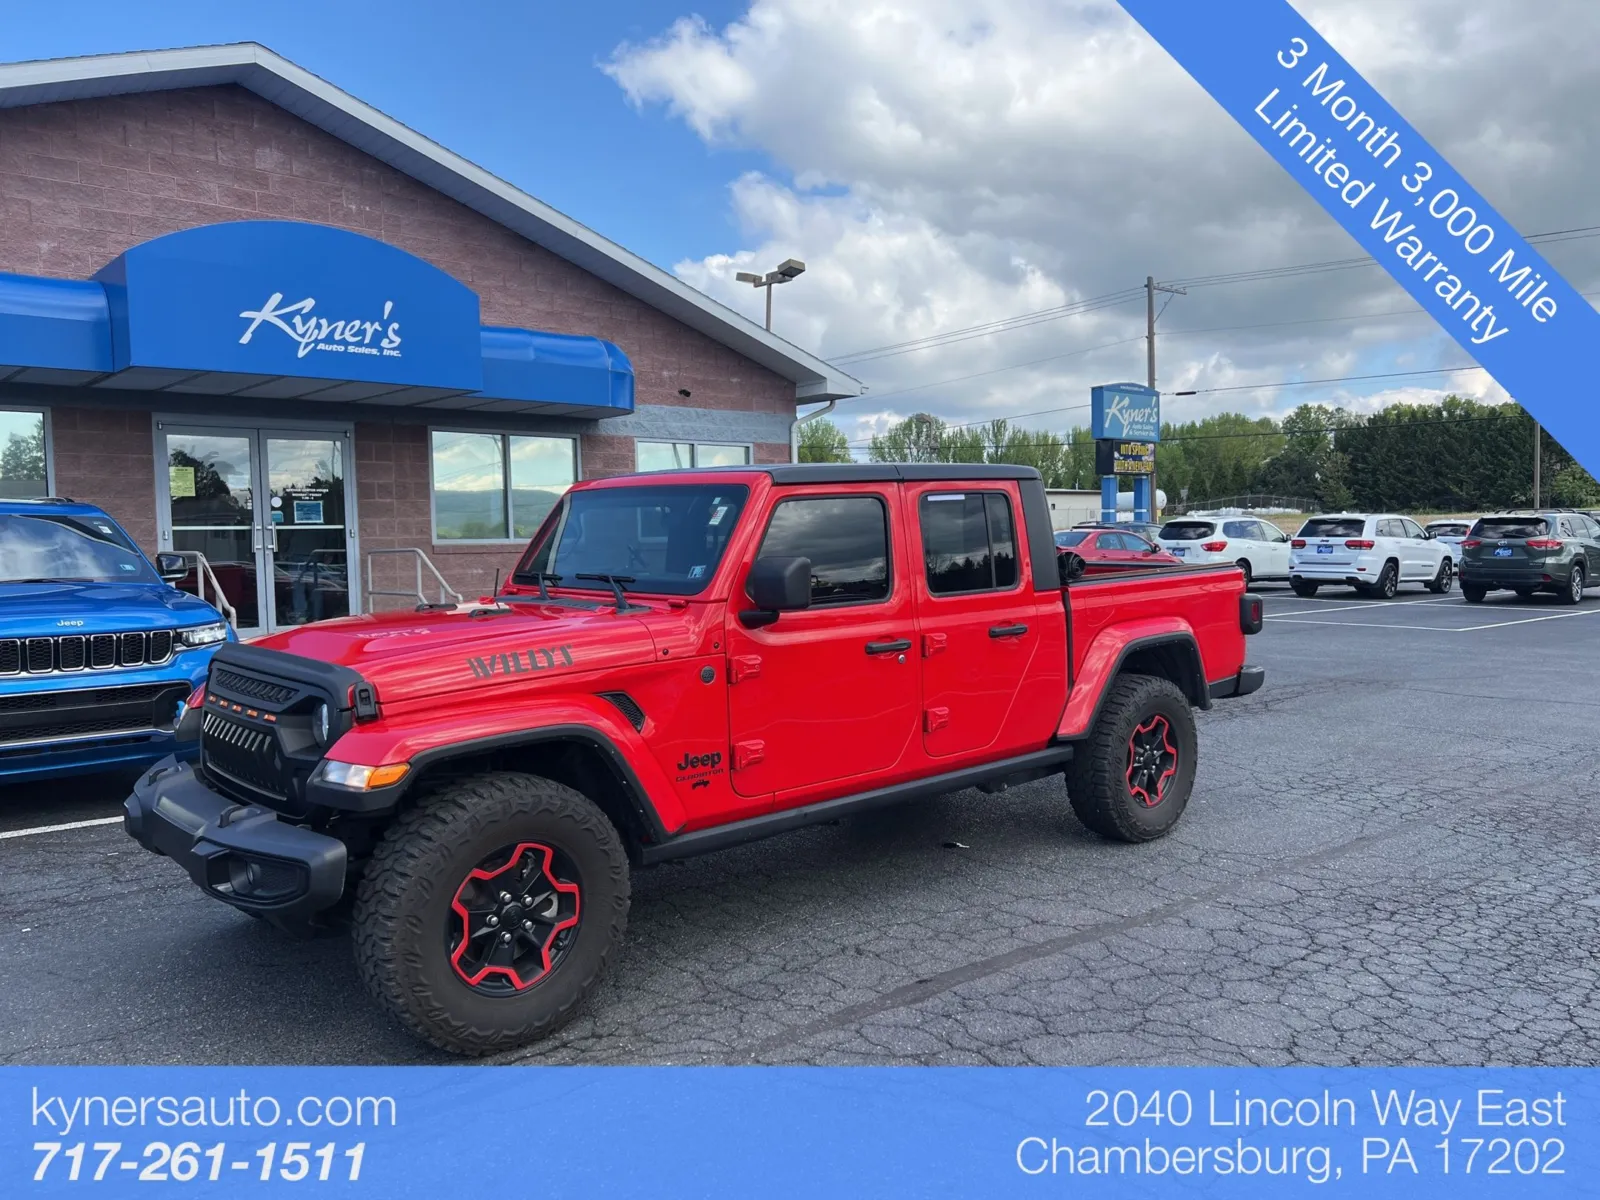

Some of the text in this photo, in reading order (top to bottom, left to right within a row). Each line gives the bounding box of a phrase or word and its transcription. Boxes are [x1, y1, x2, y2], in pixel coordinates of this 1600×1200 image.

[239, 292, 401, 358] Kyner's
[316, 343, 402, 357] Auto Sales, Inc.
[1104, 395, 1158, 438] Kyner's
[57, 619, 84, 627] Jeep
[466, 644, 575, 680] WILLYS
[677, 752, 722, 770] Jeep
